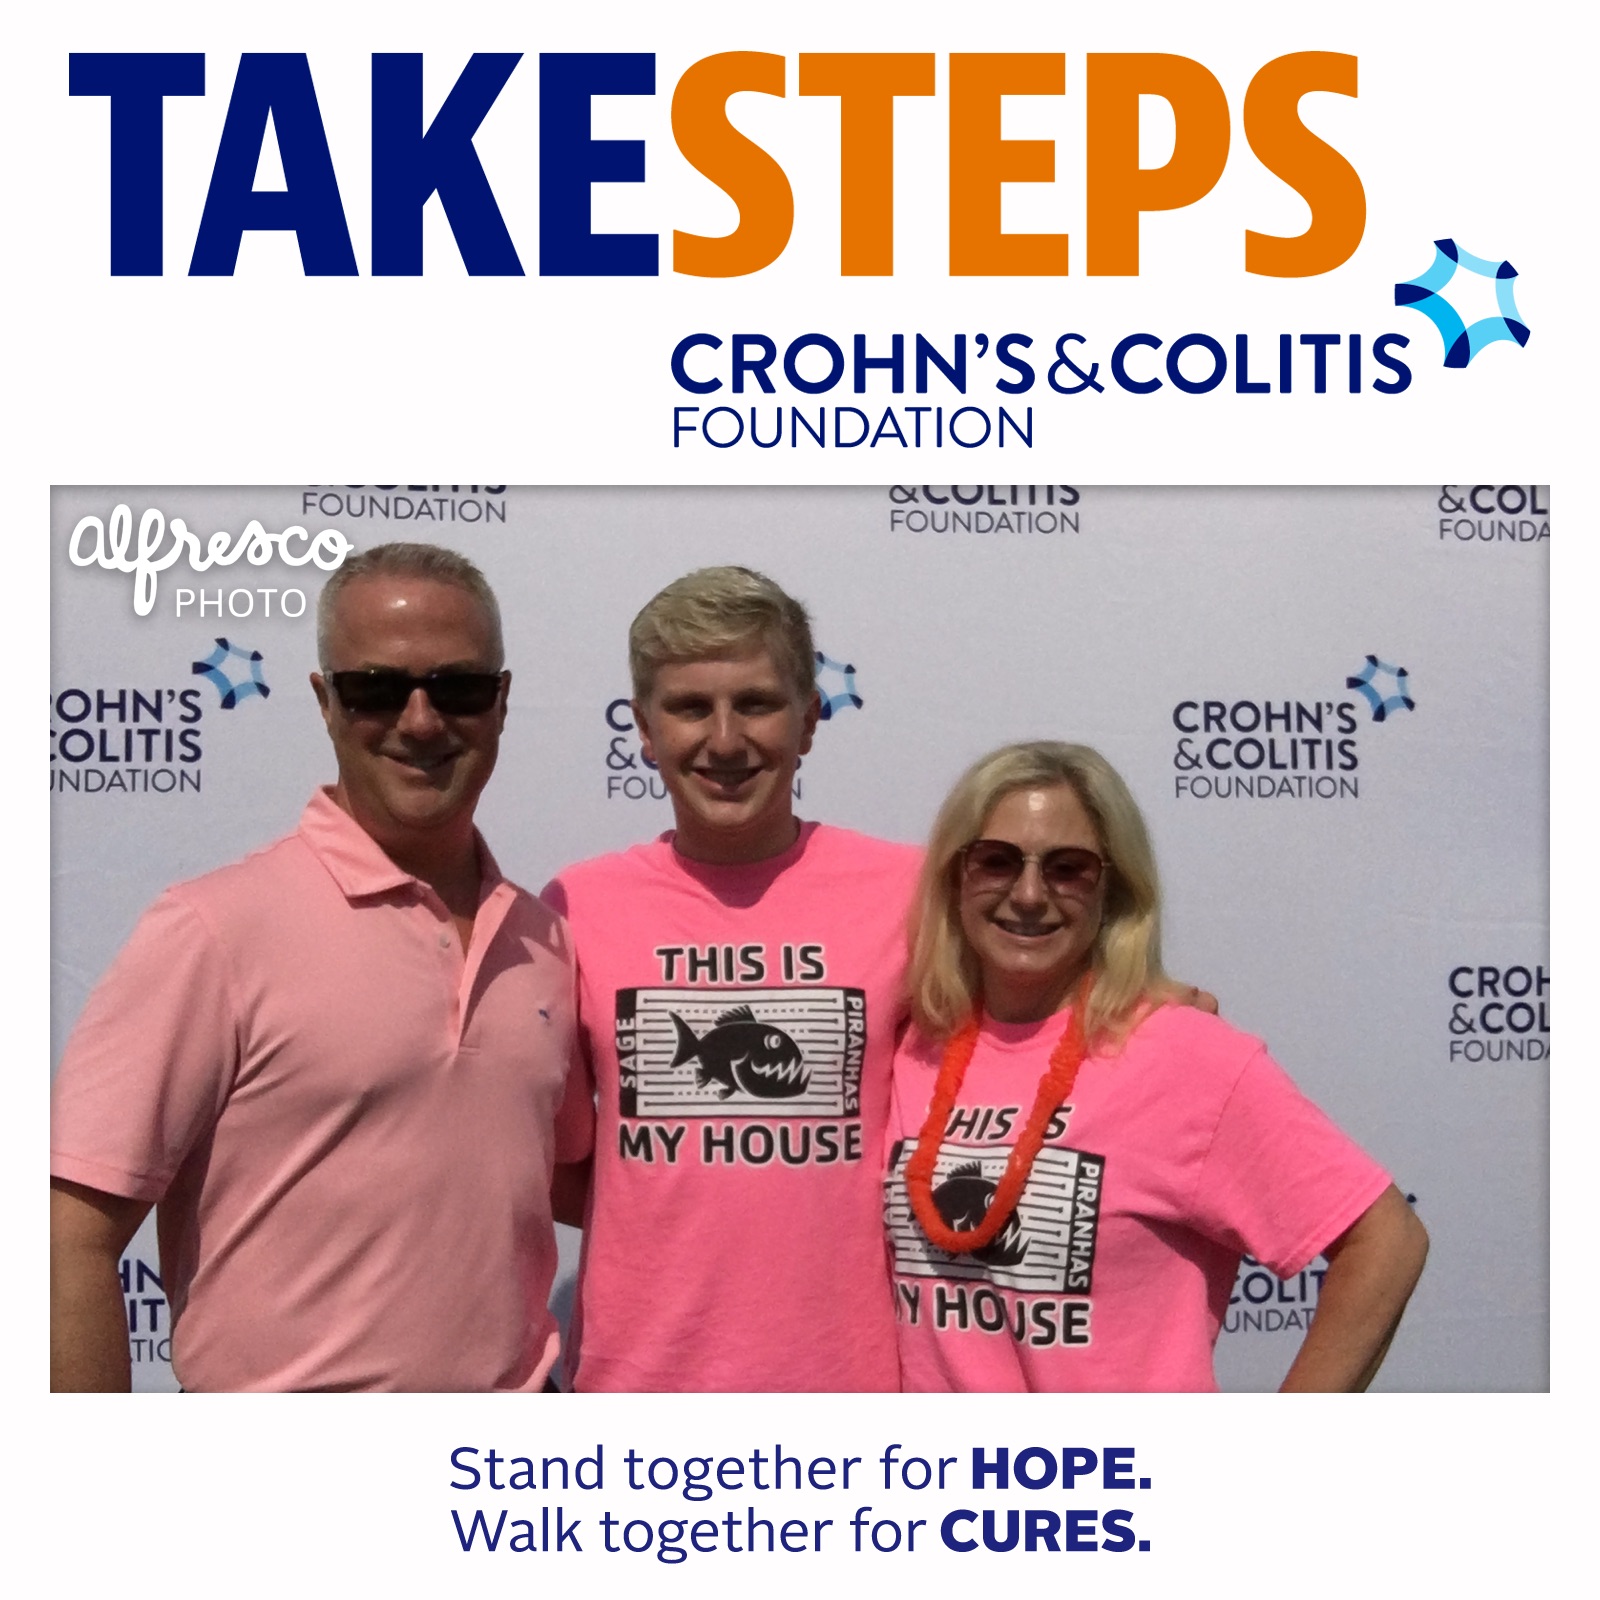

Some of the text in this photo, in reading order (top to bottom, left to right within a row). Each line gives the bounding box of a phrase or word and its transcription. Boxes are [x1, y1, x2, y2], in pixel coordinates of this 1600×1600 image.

[302, 492, 506, 523] FOUNDATION
[890, 509, 1080, 534] FOUNDATION
[50, 688, 203, 724] OHN'S
[1172, 700, 1358, 735] CROHN'S
[50, 728, 203, 764] OLITIS
[1175, 775, 1359, 799] FOUNDATION
[656, 944, 825, 982] THIS IS
[615, 1016, 637, 1089] SAGE
[846, 996, 864, 1112] PIRANHAS
[1449, 1038, 1550, 1062] FOUND
[944, 1107, 1019, 1140] HIS
[619, 1123, 862, 1165] MY HOUSE
[1067, 1161, 1100, 1289] PIRANHAS
